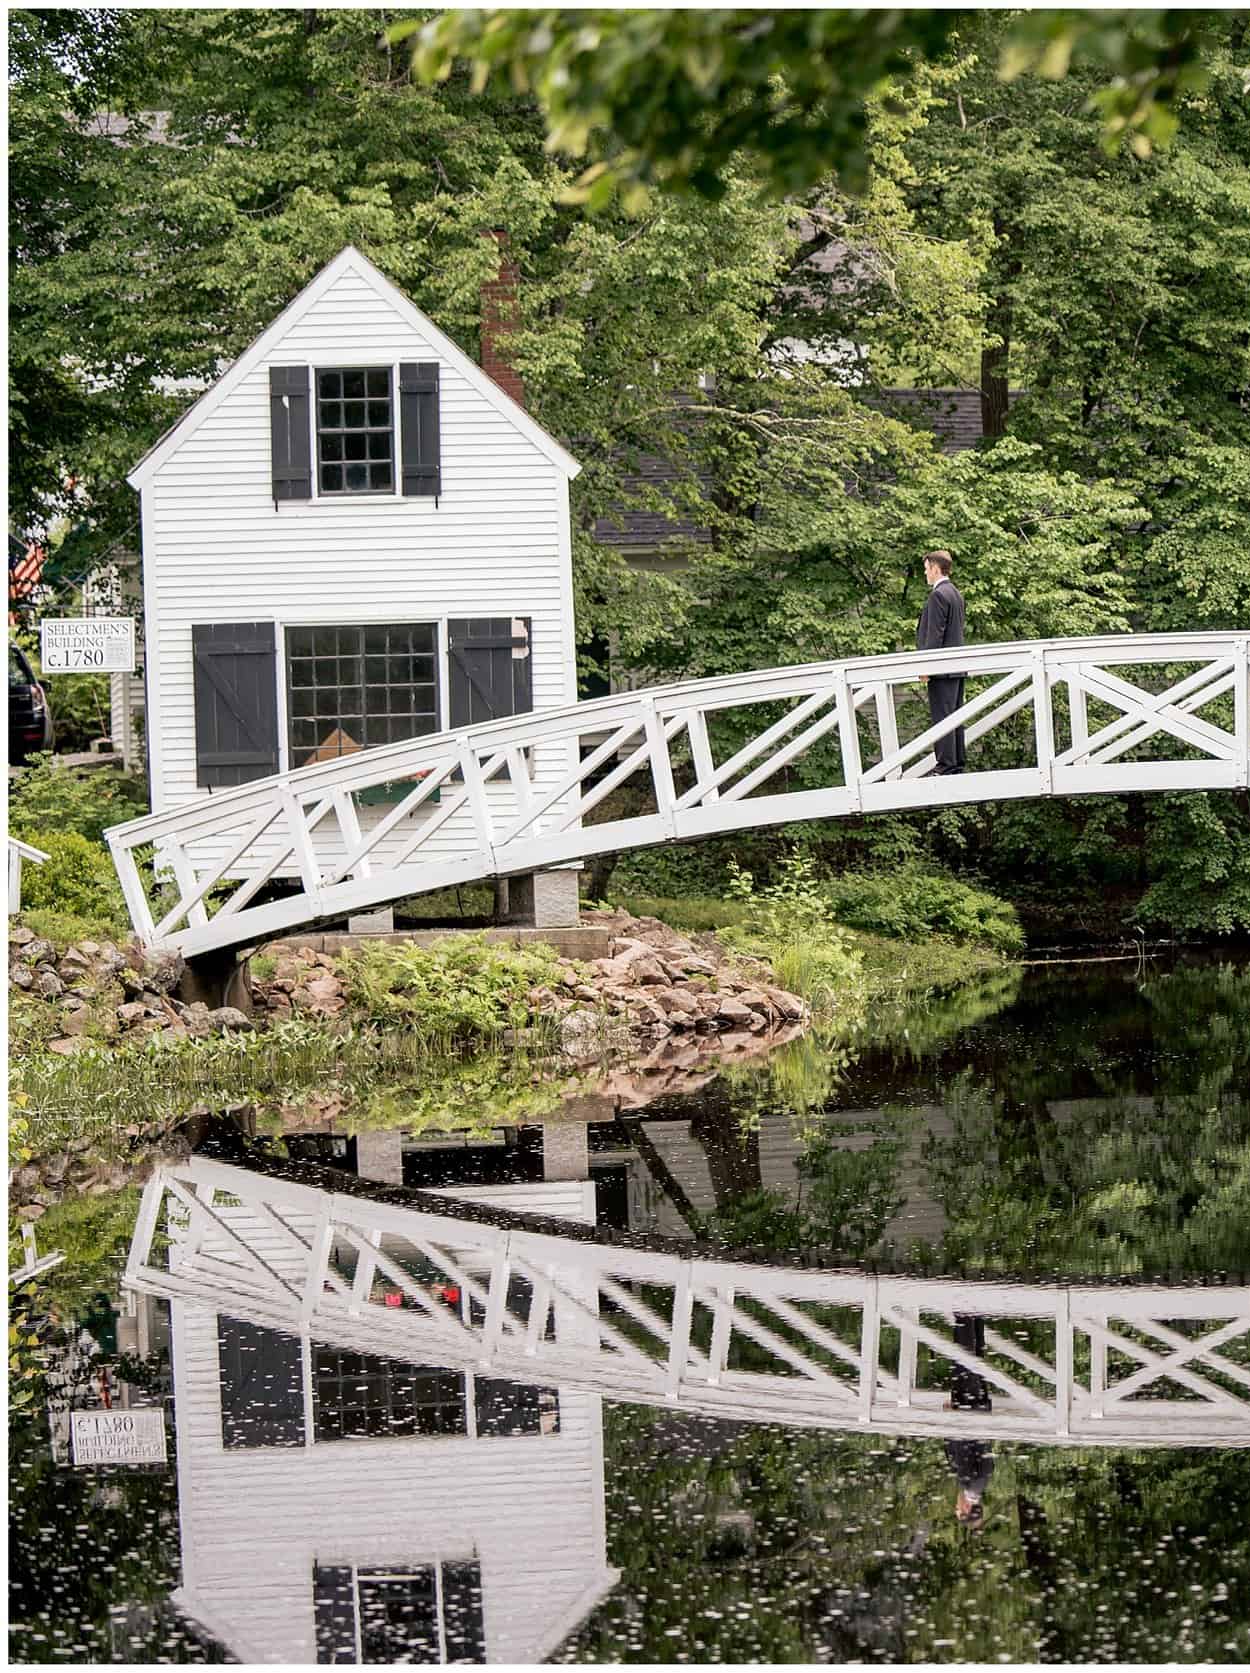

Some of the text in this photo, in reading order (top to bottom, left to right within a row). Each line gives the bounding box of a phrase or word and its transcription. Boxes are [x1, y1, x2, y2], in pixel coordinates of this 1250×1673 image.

[47, 624, 129, 636] SELECTMEN'S
[47, 637, 104, 648] BUILDING
[48, 650, 104, 667] c.1780
